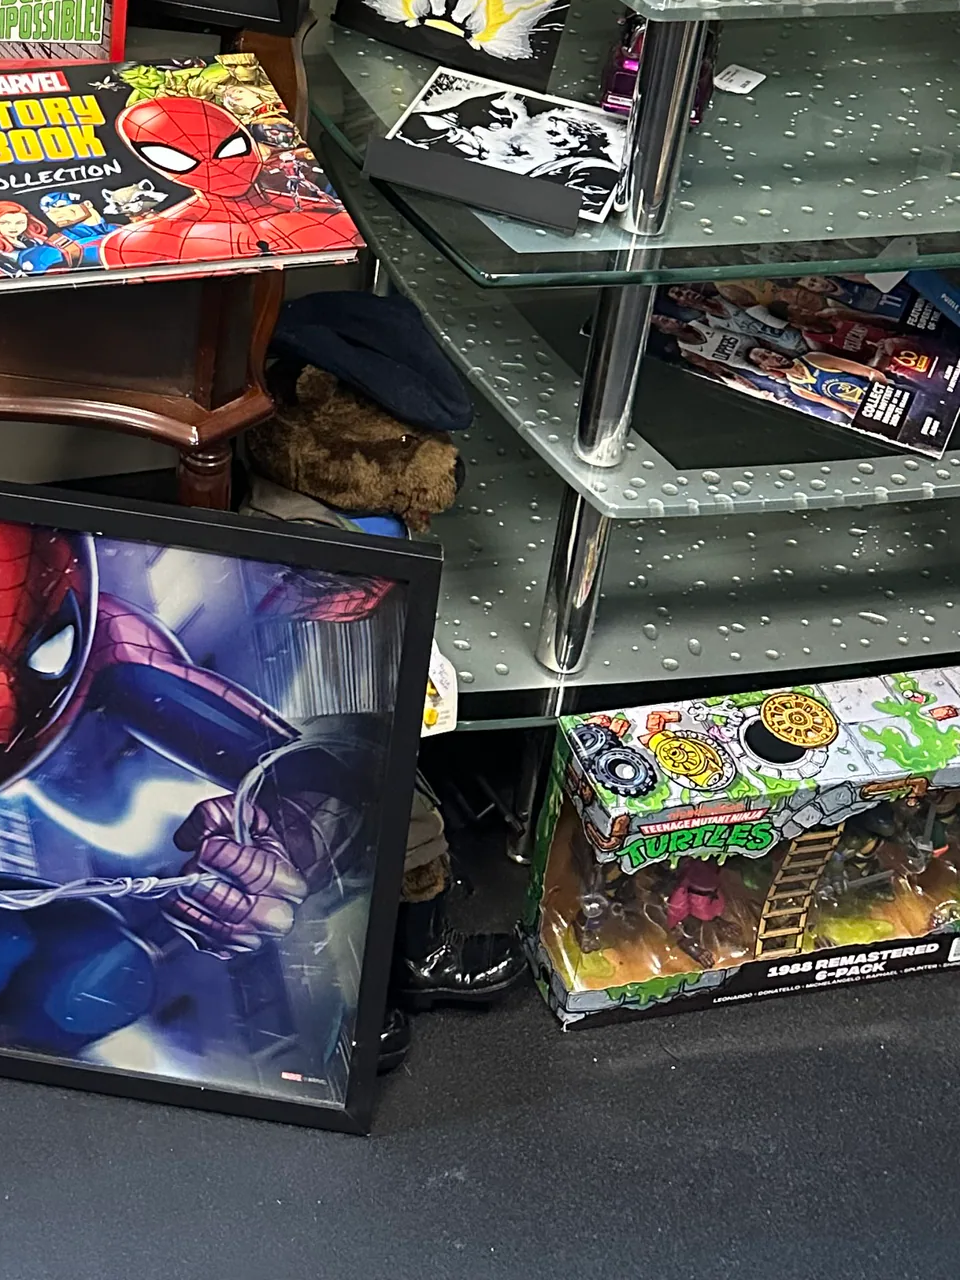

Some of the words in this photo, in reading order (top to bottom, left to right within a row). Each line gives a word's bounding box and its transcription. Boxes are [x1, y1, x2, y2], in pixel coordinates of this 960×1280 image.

[712, 334, 739, 361] CLIPPERS
[861, 381, 886, 418] COLLECT
[641, 821, 691, 834] TEENAGE
[690, 814, 731, 827] MUTANT
[730, 809, 764, 822] NINJA
[618, 822, 774, 868] TURTLES
[767, 961, 813, 978] 1988
[815, 942, 940, 970] REMASTERED
[815, 961, 887, 982] 6-PACK
[713, 992, 753, 1003] LEONARDO
[758, 985, 801, 996] DONATELLO
[805, 976, 862, 989] MICHELANGELO
[866, 970, 898, 980] RAPHAEL
[904, 964, 937, 974] SPLINTER
